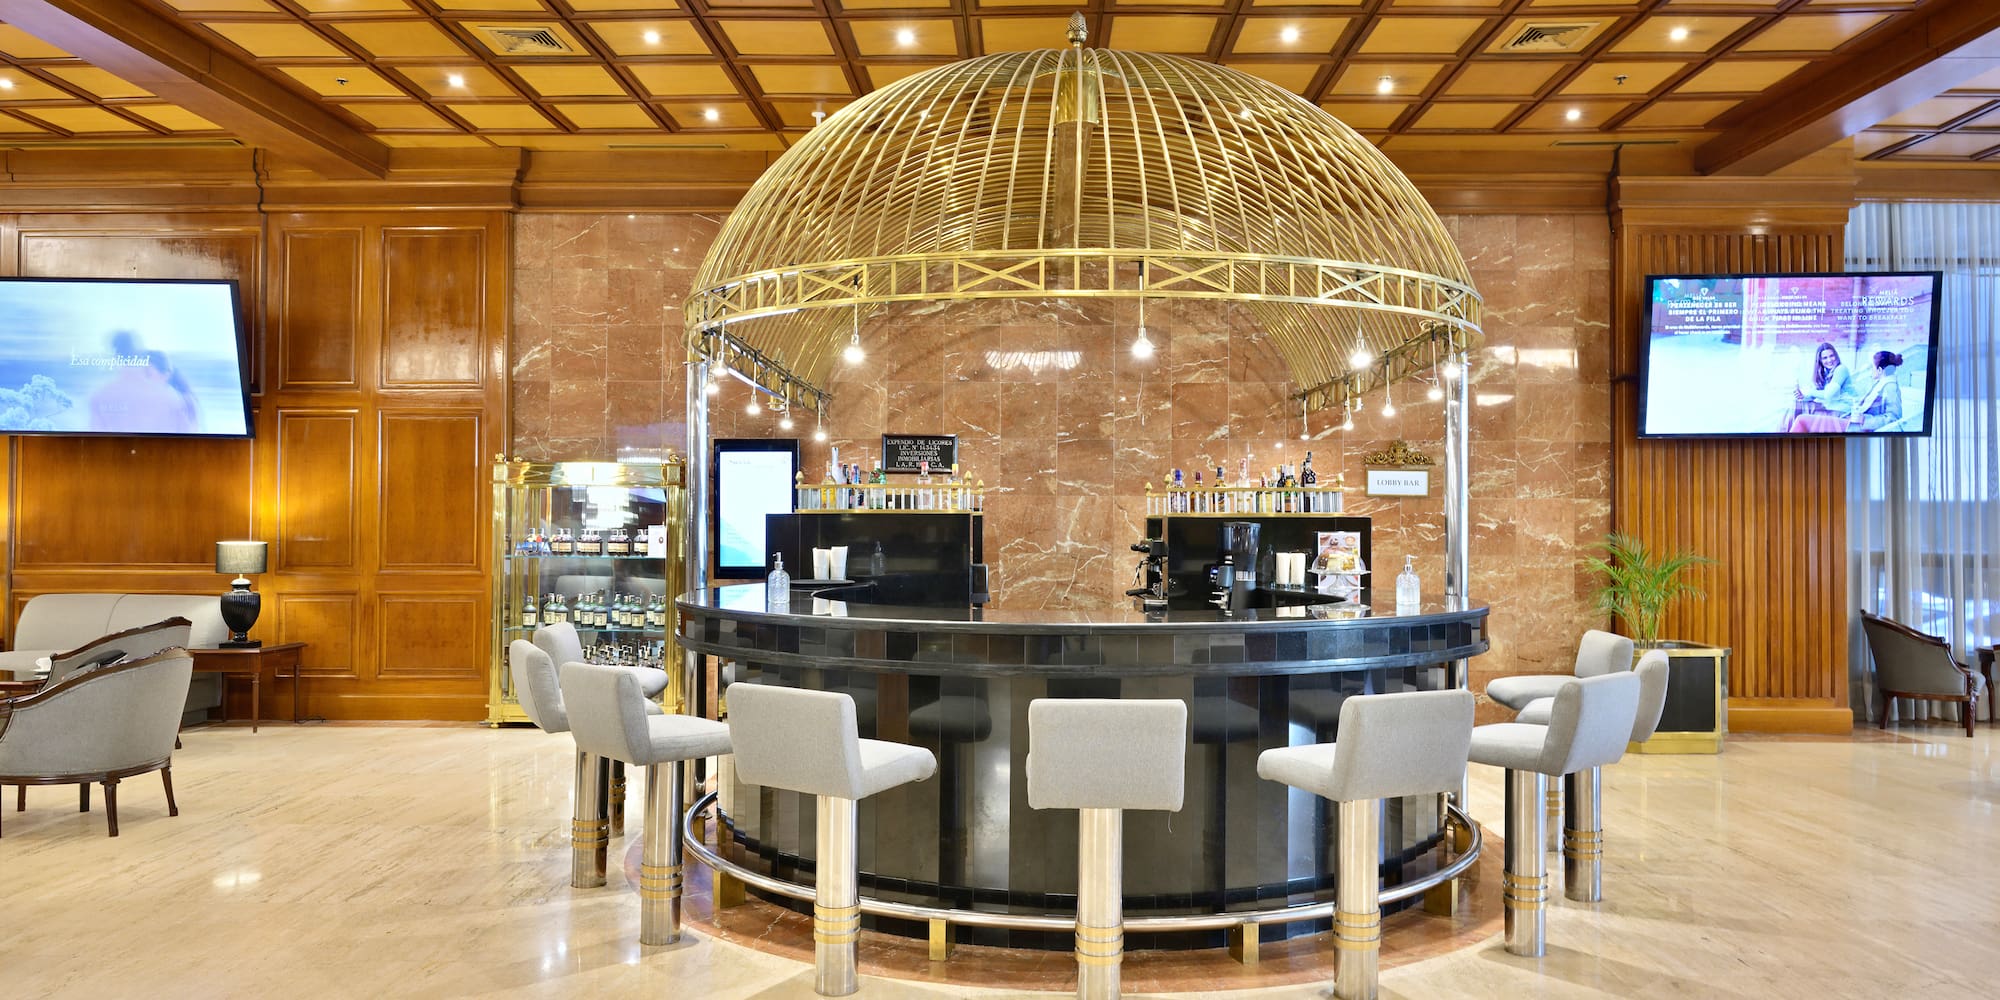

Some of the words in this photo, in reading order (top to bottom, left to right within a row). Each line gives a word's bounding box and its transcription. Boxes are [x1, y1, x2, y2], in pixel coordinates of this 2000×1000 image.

[1862, 296, 1914, 306] REWARDS
[71, 353, 89, 366] Esa
[92, 355, 149, 370] complicidad
